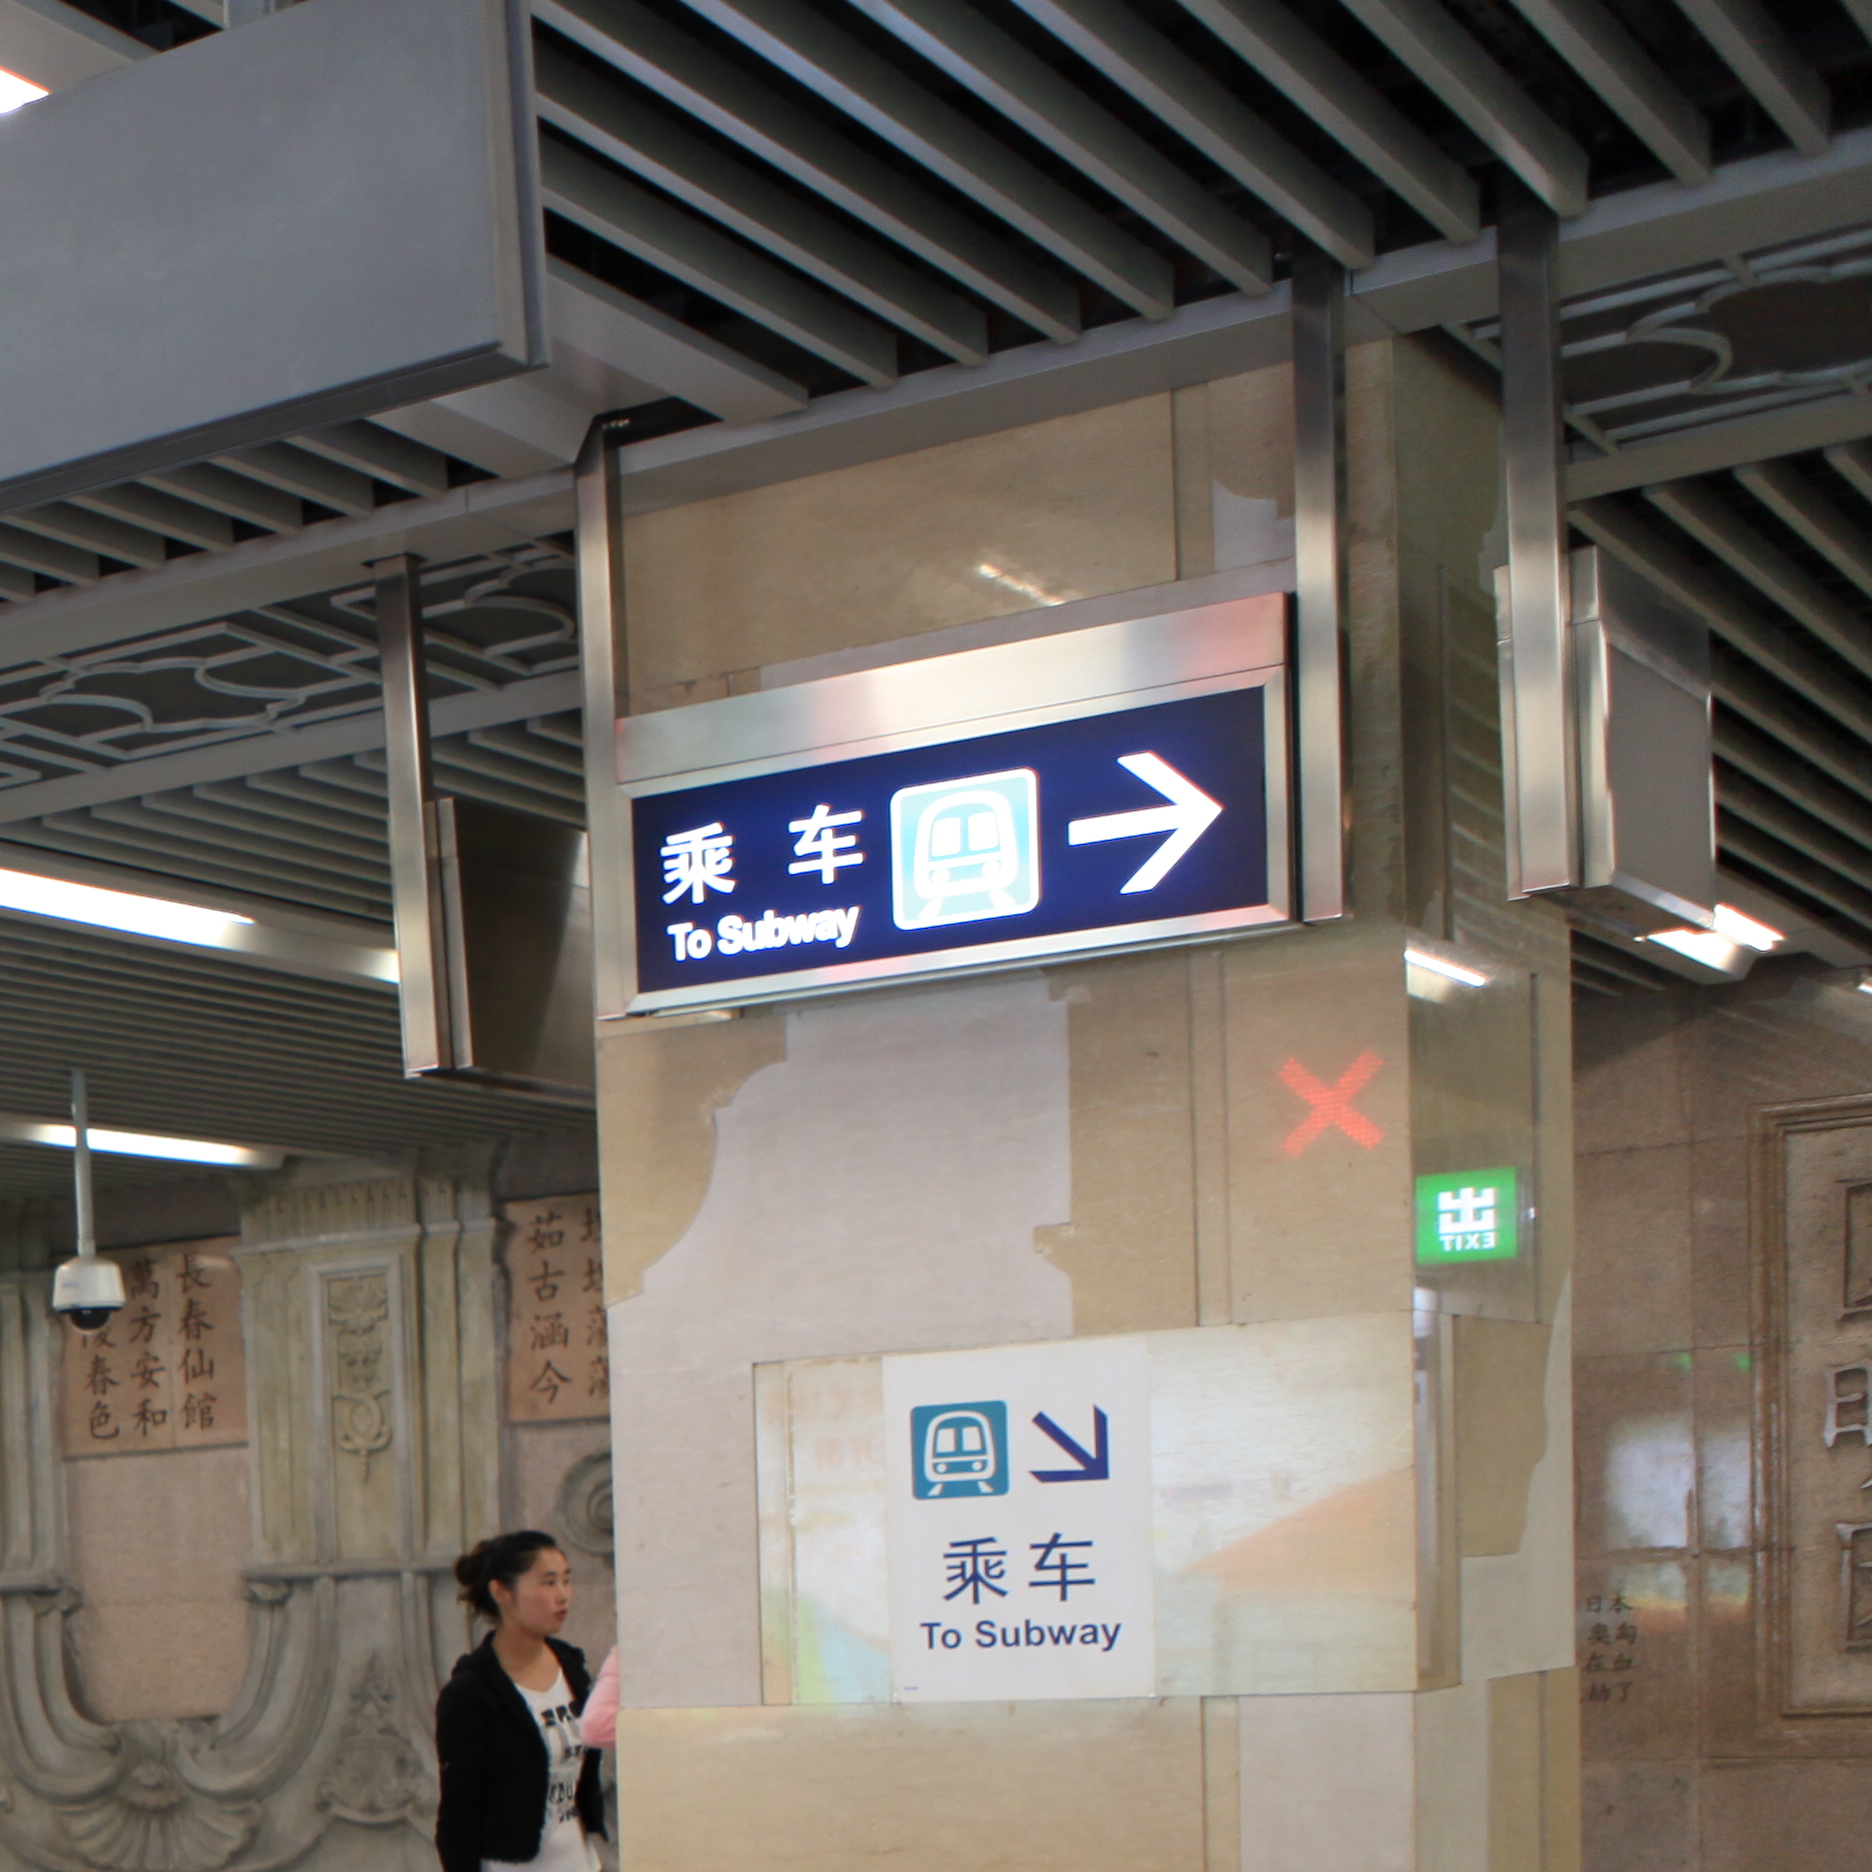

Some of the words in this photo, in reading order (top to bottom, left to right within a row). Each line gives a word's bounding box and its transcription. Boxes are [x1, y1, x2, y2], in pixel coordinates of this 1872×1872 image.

[660, 802, 864, 905] 乘车
[667, 920, 713, 962] To
[716, 905, 859, 957] Subway
[129, 1257, 167, 1437] 萬方安和
[526, 1209, 574, 1404] 茹古涵今
[942, 1532, 1097, 1606] 乘车
[920, 1621, 962, 1650] To
[974, 1619, 1122, 1652] Subway
